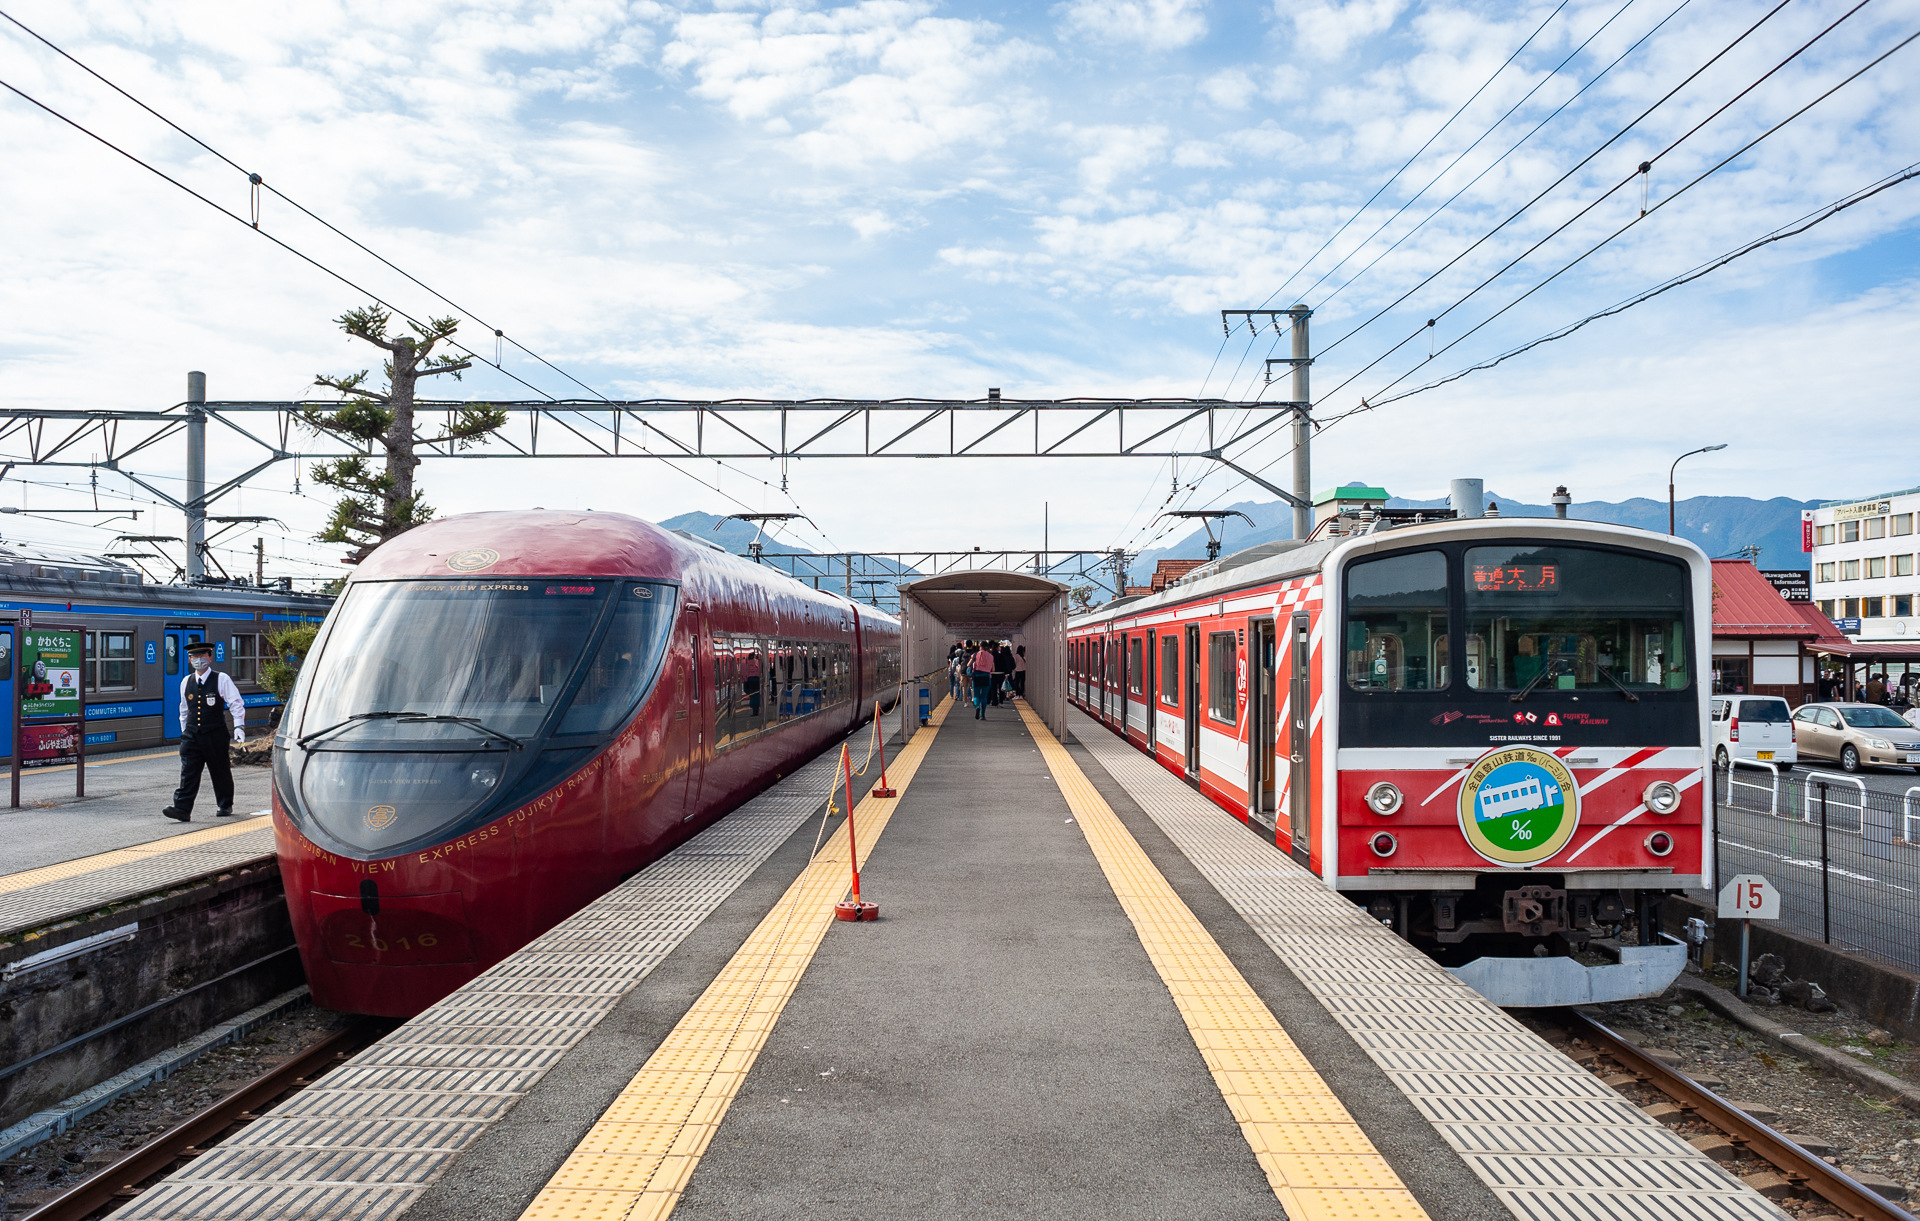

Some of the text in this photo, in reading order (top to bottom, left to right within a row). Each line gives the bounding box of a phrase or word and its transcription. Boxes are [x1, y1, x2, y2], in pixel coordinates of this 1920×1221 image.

[38, 636, 72, 648] かわぐちこ
[88, 708, 116, 716] COMMUTER
[298, 748, 614, 874] FUJISAN VIEW EXPRESS FUJIKYU RAILWAY
[1736, 883, 1763, 909] 15
[346, 933, 438, 952] 2016
